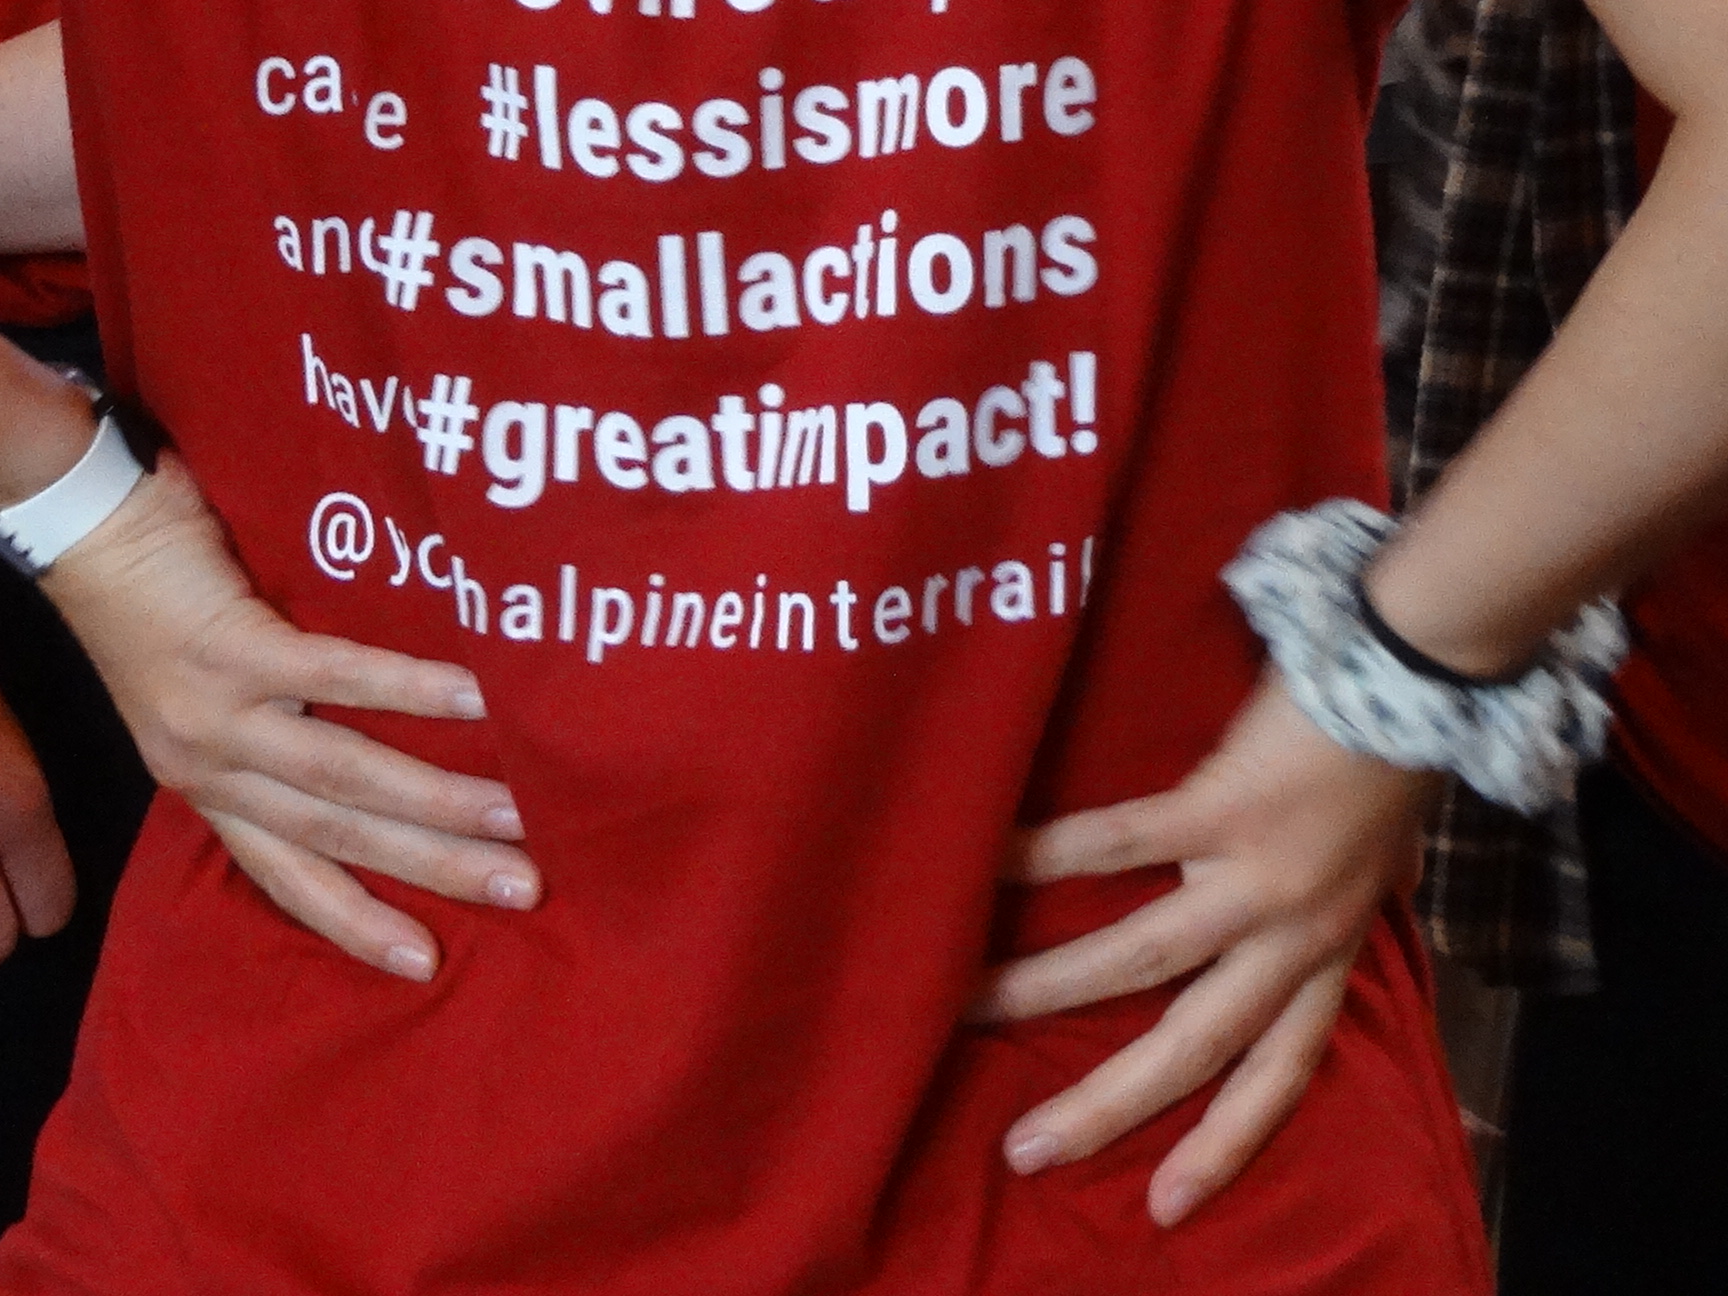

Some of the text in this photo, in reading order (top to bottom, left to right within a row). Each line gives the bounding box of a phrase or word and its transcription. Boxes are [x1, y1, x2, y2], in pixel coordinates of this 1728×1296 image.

[256, 54, 1098, 182] cae #lessismore
[377, 209, 1100, 338] #smallactions
[417, 351, 1100, 511] #greatimpact!
